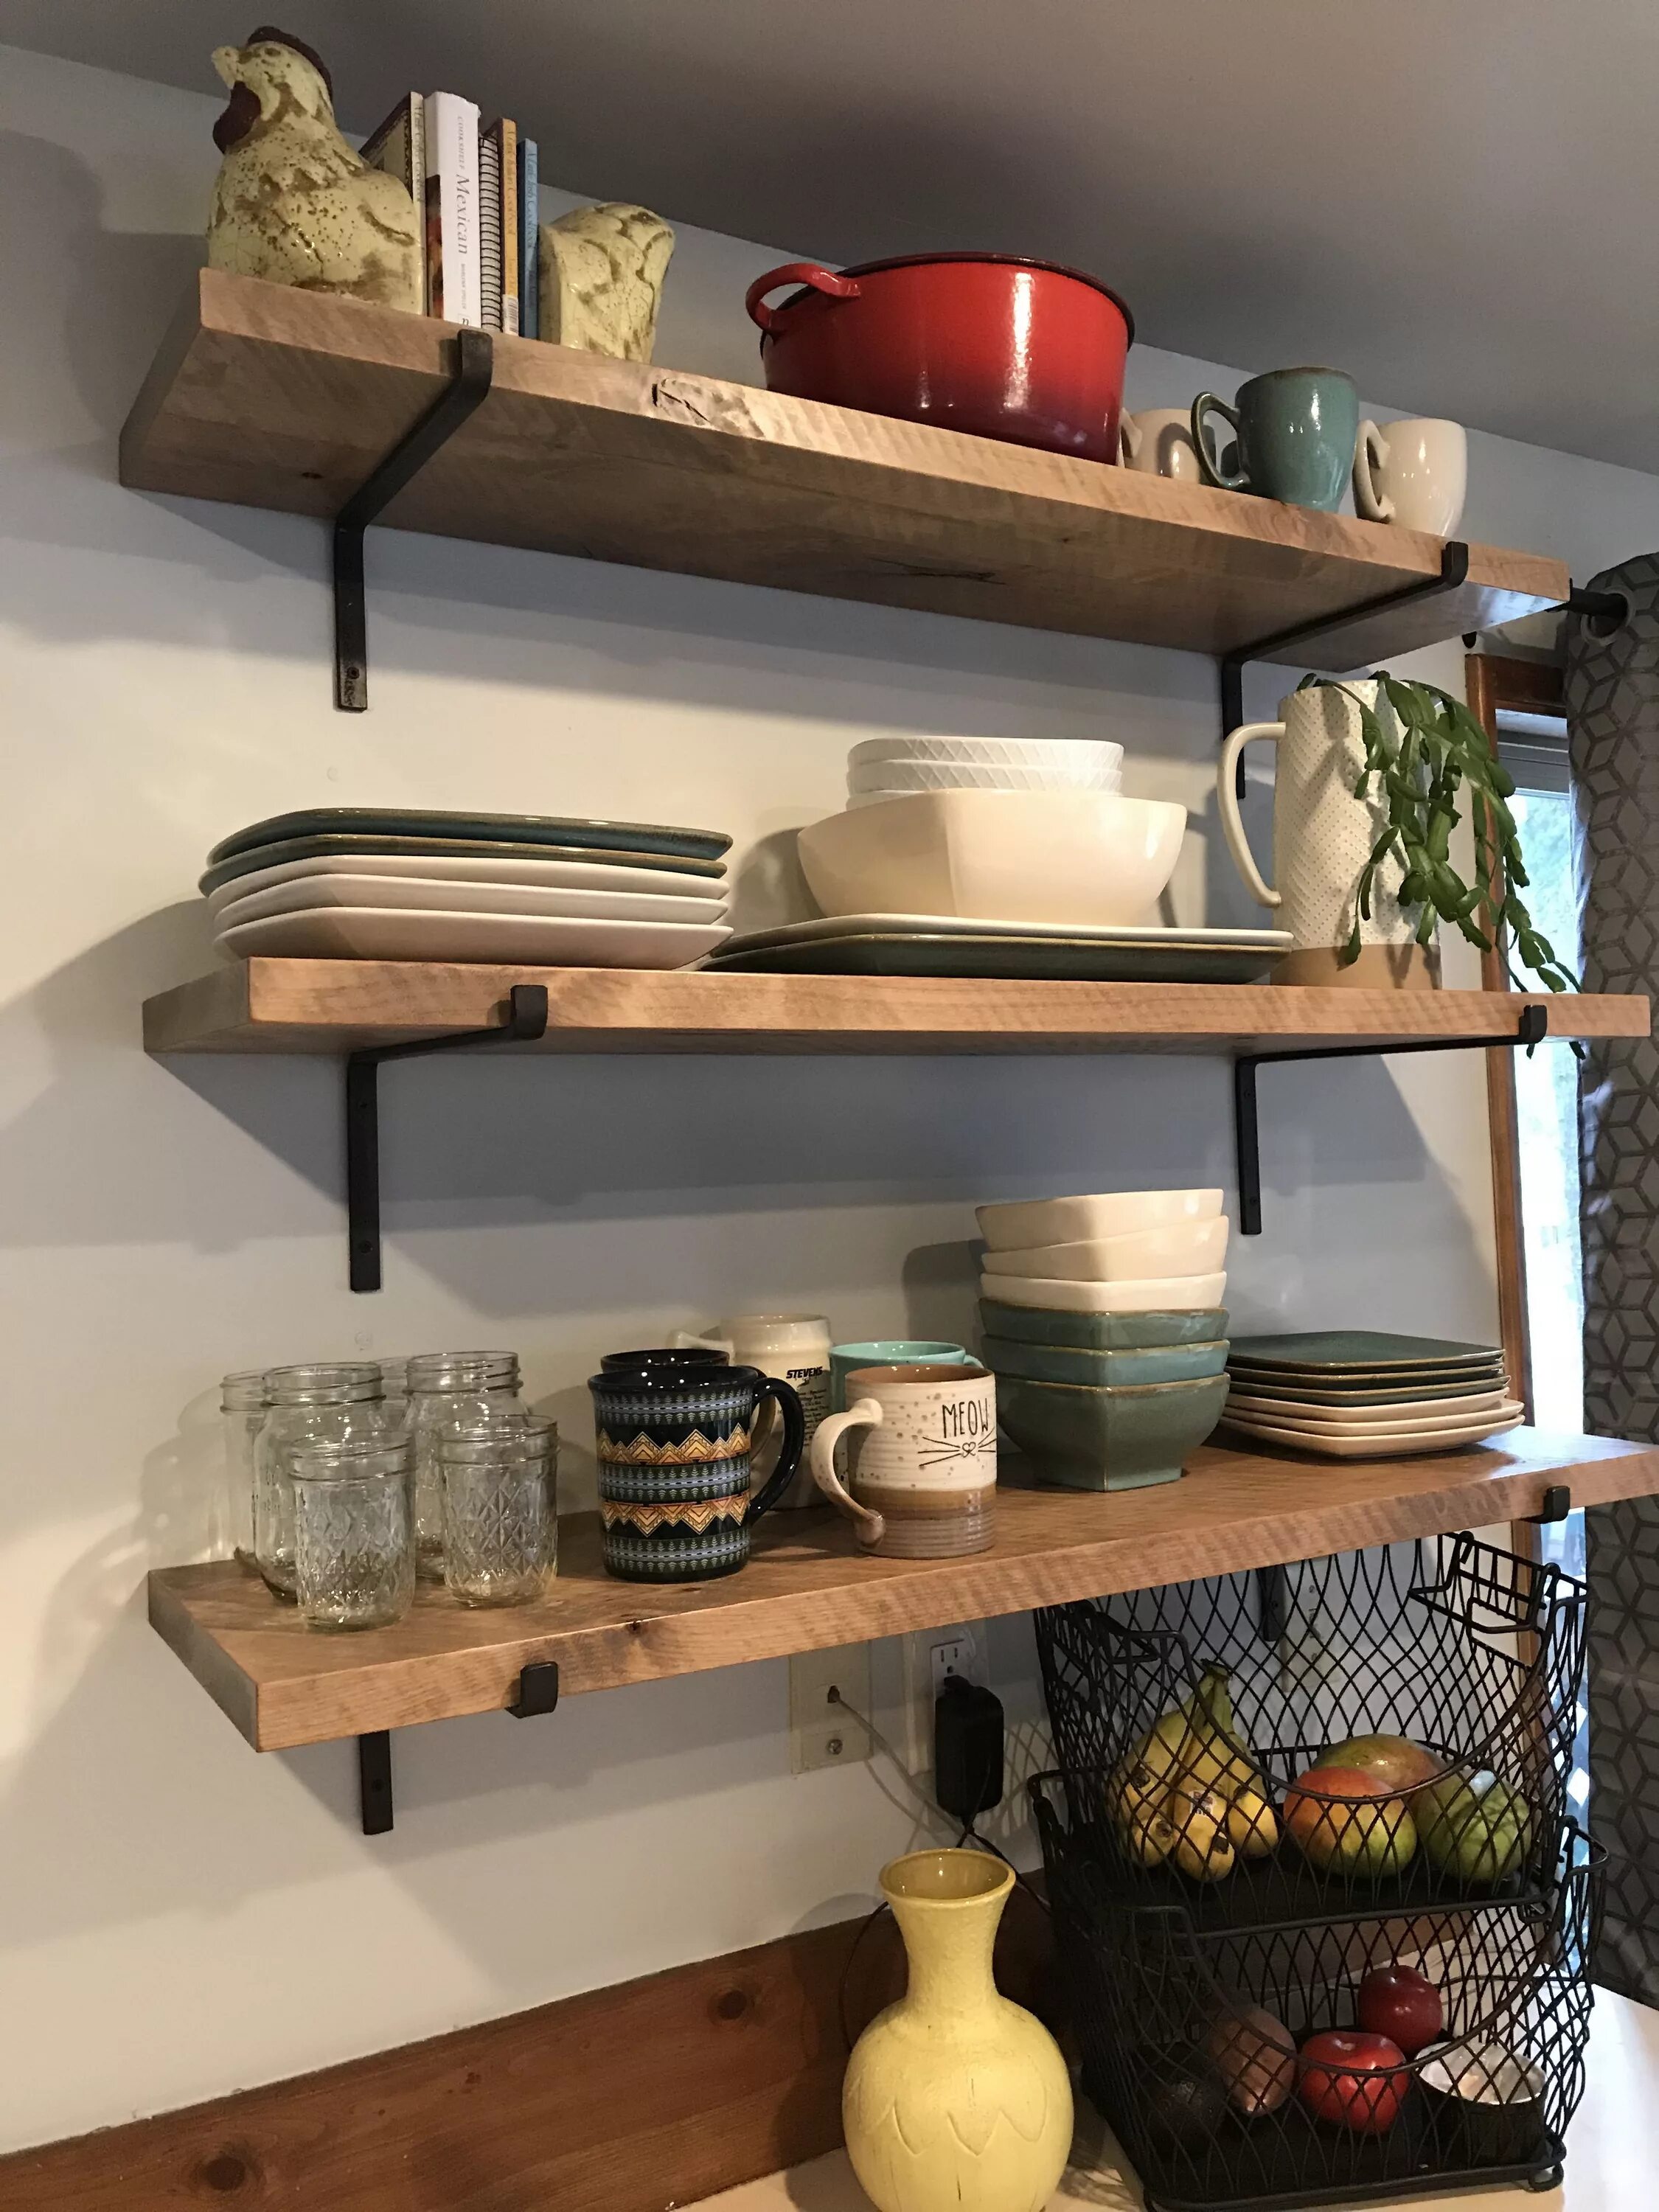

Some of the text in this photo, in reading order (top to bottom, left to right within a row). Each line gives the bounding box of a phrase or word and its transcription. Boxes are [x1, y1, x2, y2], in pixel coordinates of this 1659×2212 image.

[456, 173, 470, 254] Mexican
[785, 1366, 823, 1380] STEVENS
[942, 1397, 990, 1439] MEOW
